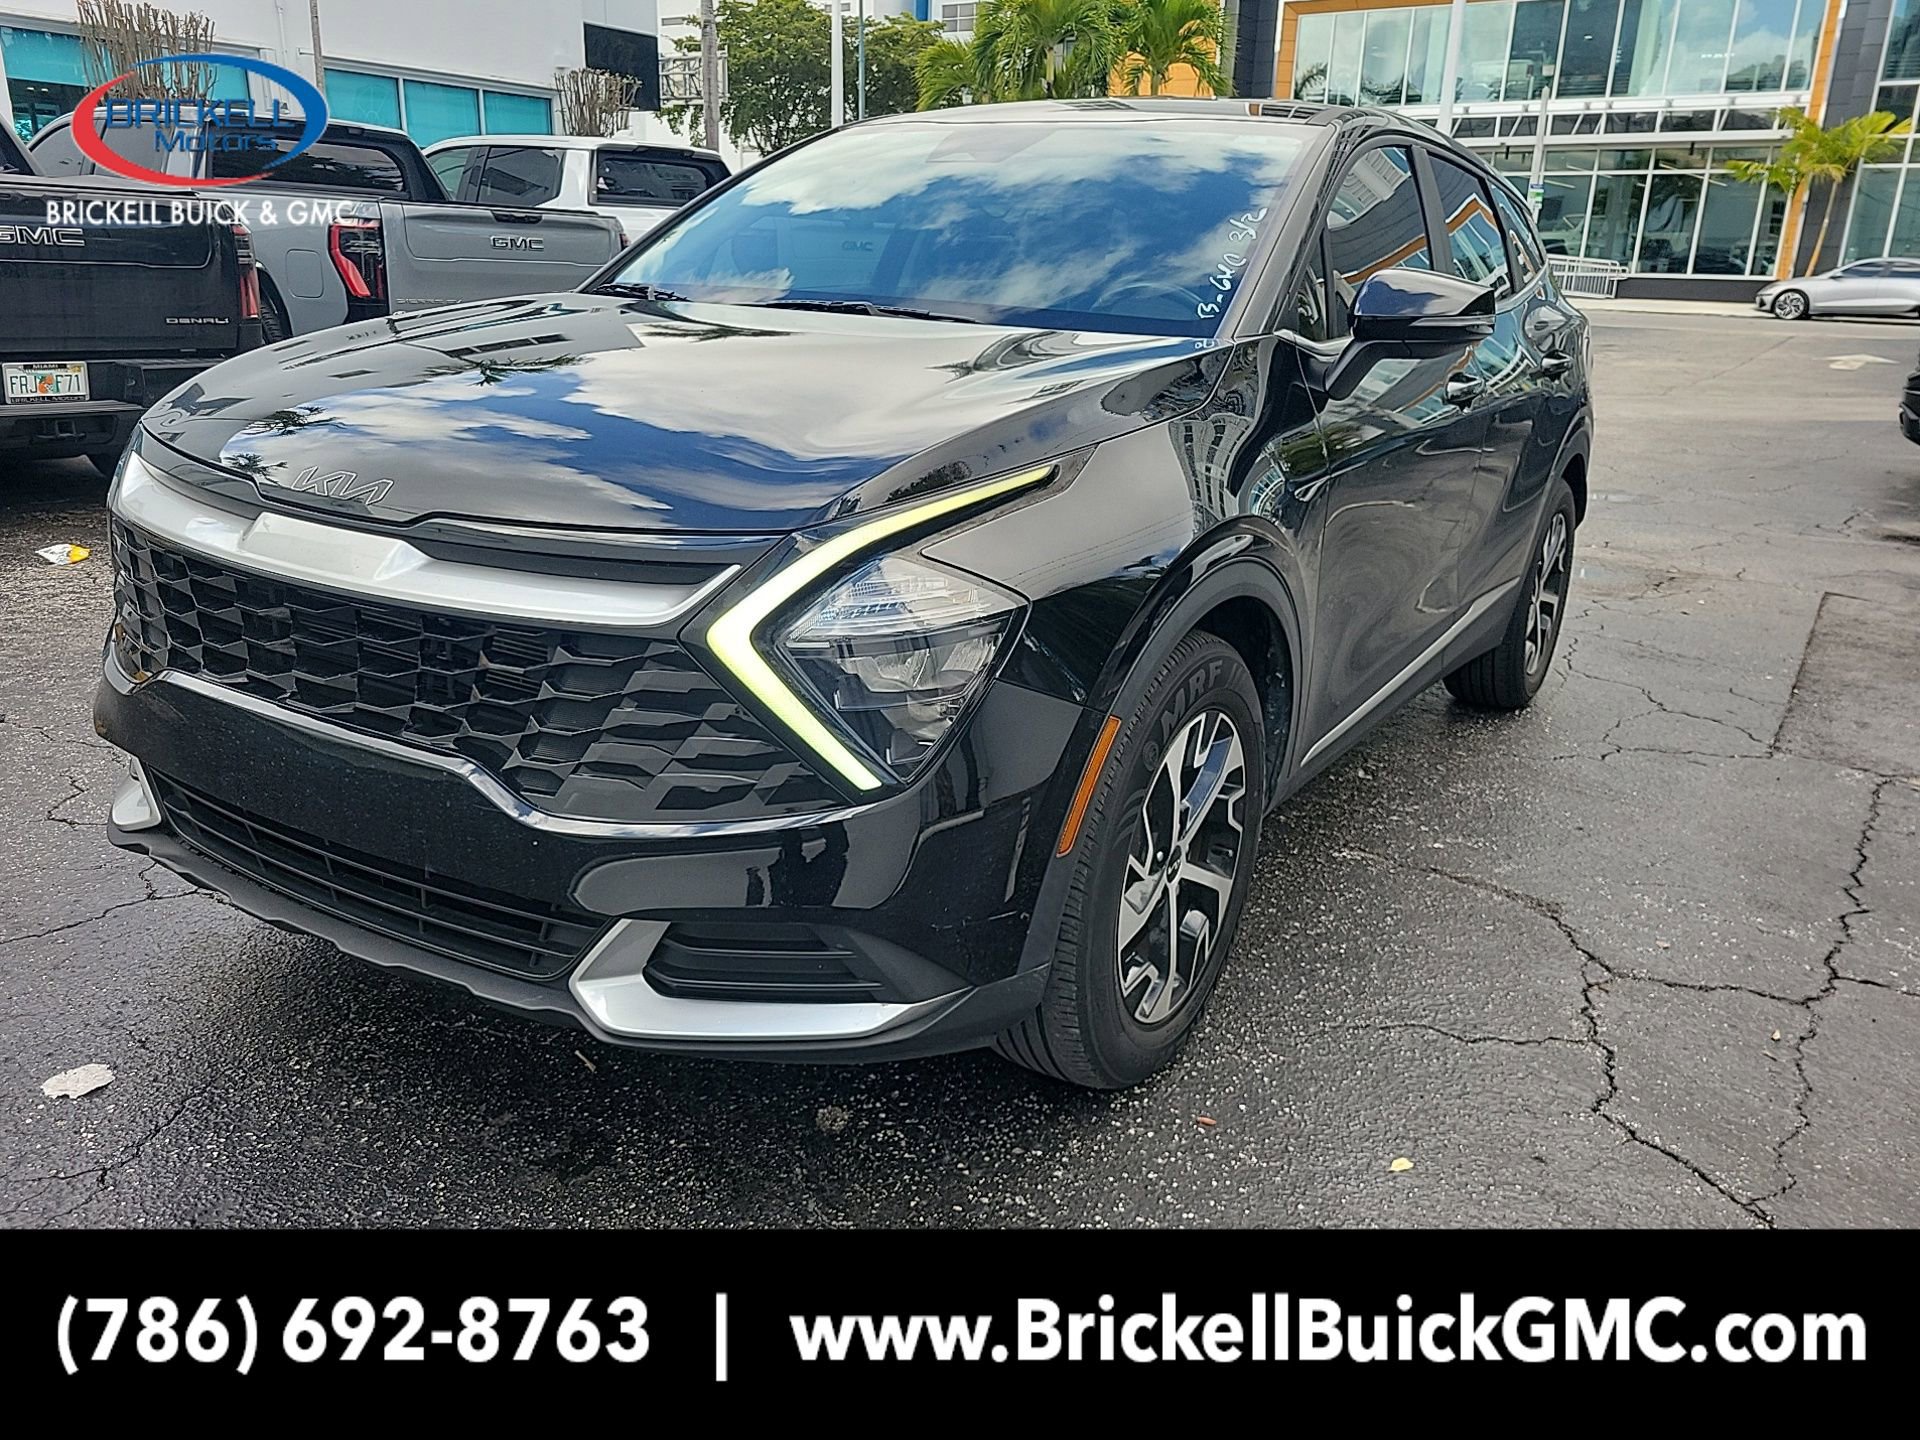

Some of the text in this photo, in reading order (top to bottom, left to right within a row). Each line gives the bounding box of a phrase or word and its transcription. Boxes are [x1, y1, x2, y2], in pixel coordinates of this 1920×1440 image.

[490, 235, 544, 251] GMC
[166, 317, 229, 325] DENALI
[1160, 660, 1222, 741] MRF
